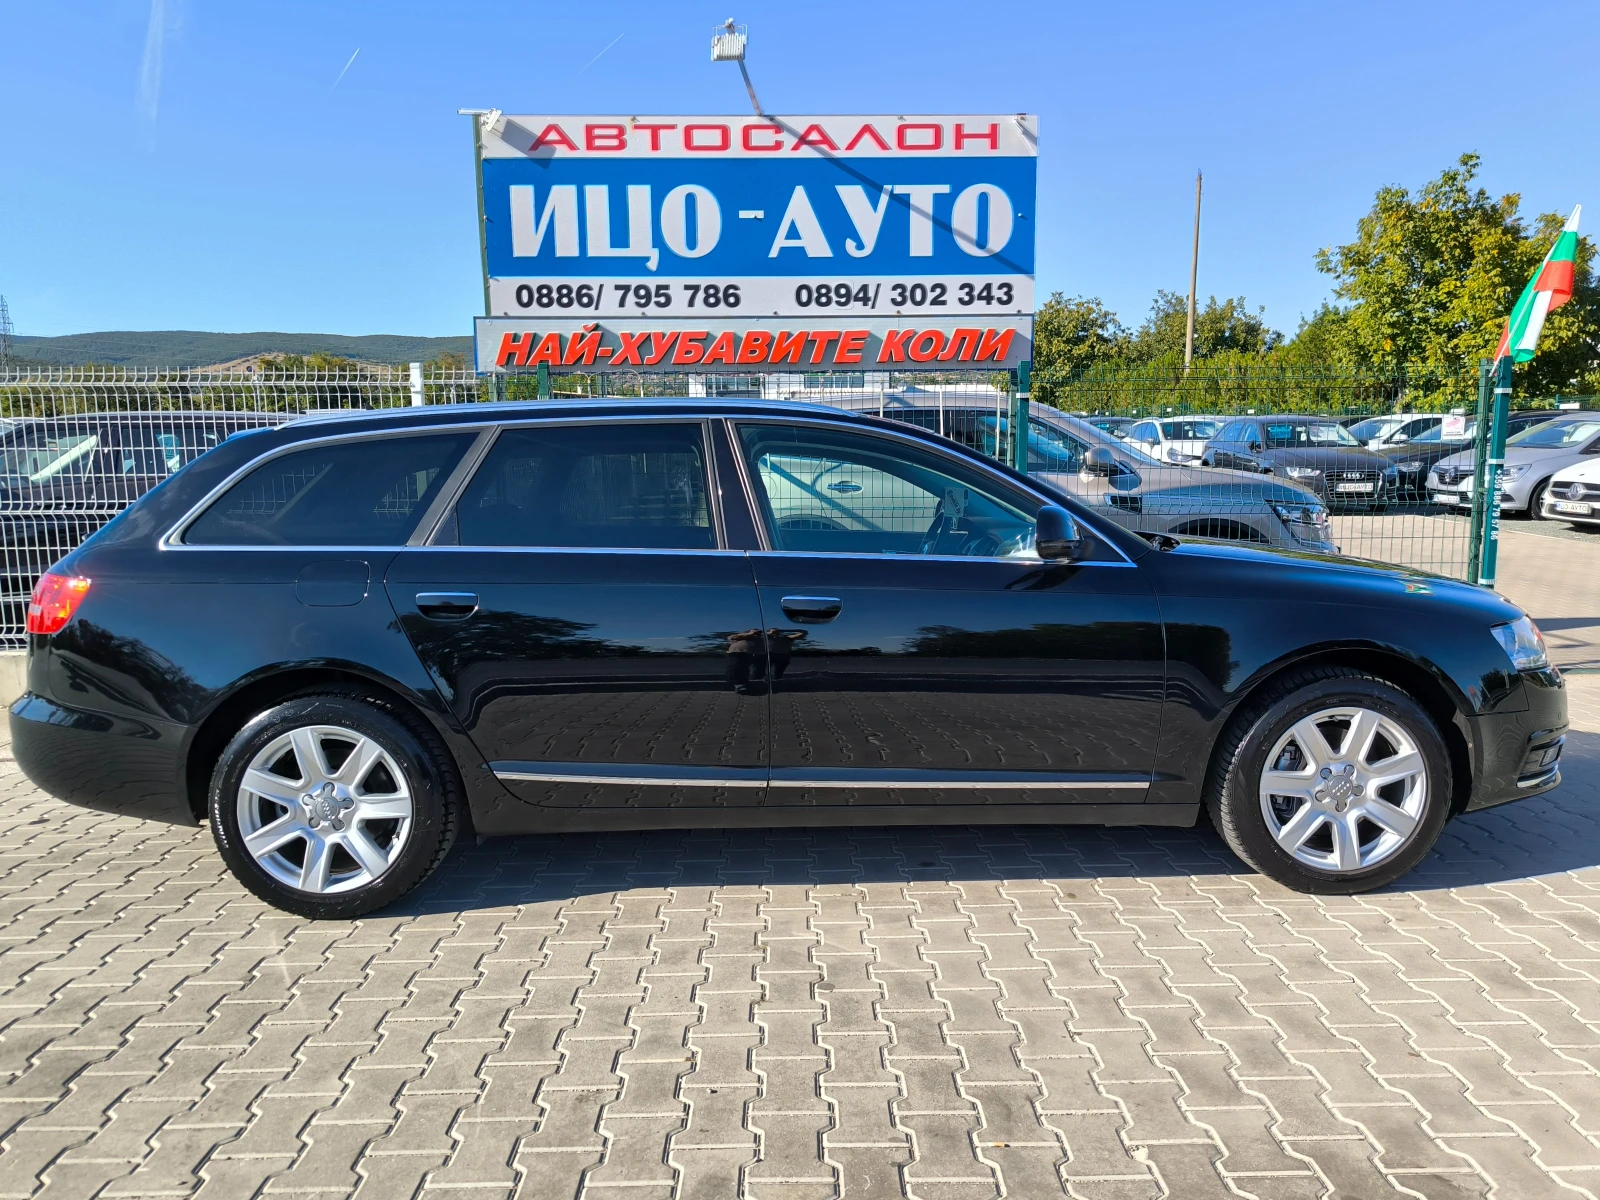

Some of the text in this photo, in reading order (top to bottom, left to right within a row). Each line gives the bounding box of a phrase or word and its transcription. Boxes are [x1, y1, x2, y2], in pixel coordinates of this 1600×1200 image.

[528, 122, 1000, 152] АВТОСАЛОН
[515, 282, 1013, 312] 0886/ 795 786 0894/ 302 343
[494, 323, 1016, 366] НАЙ-ХУБАВИТЕ КОЛИ
[1494, 469, 1502, 488] +359
[1493, 490, 1501, 505] 886
[1492, 507, 1500, 517] 79
[1491, 519, 1499, 528] 57
